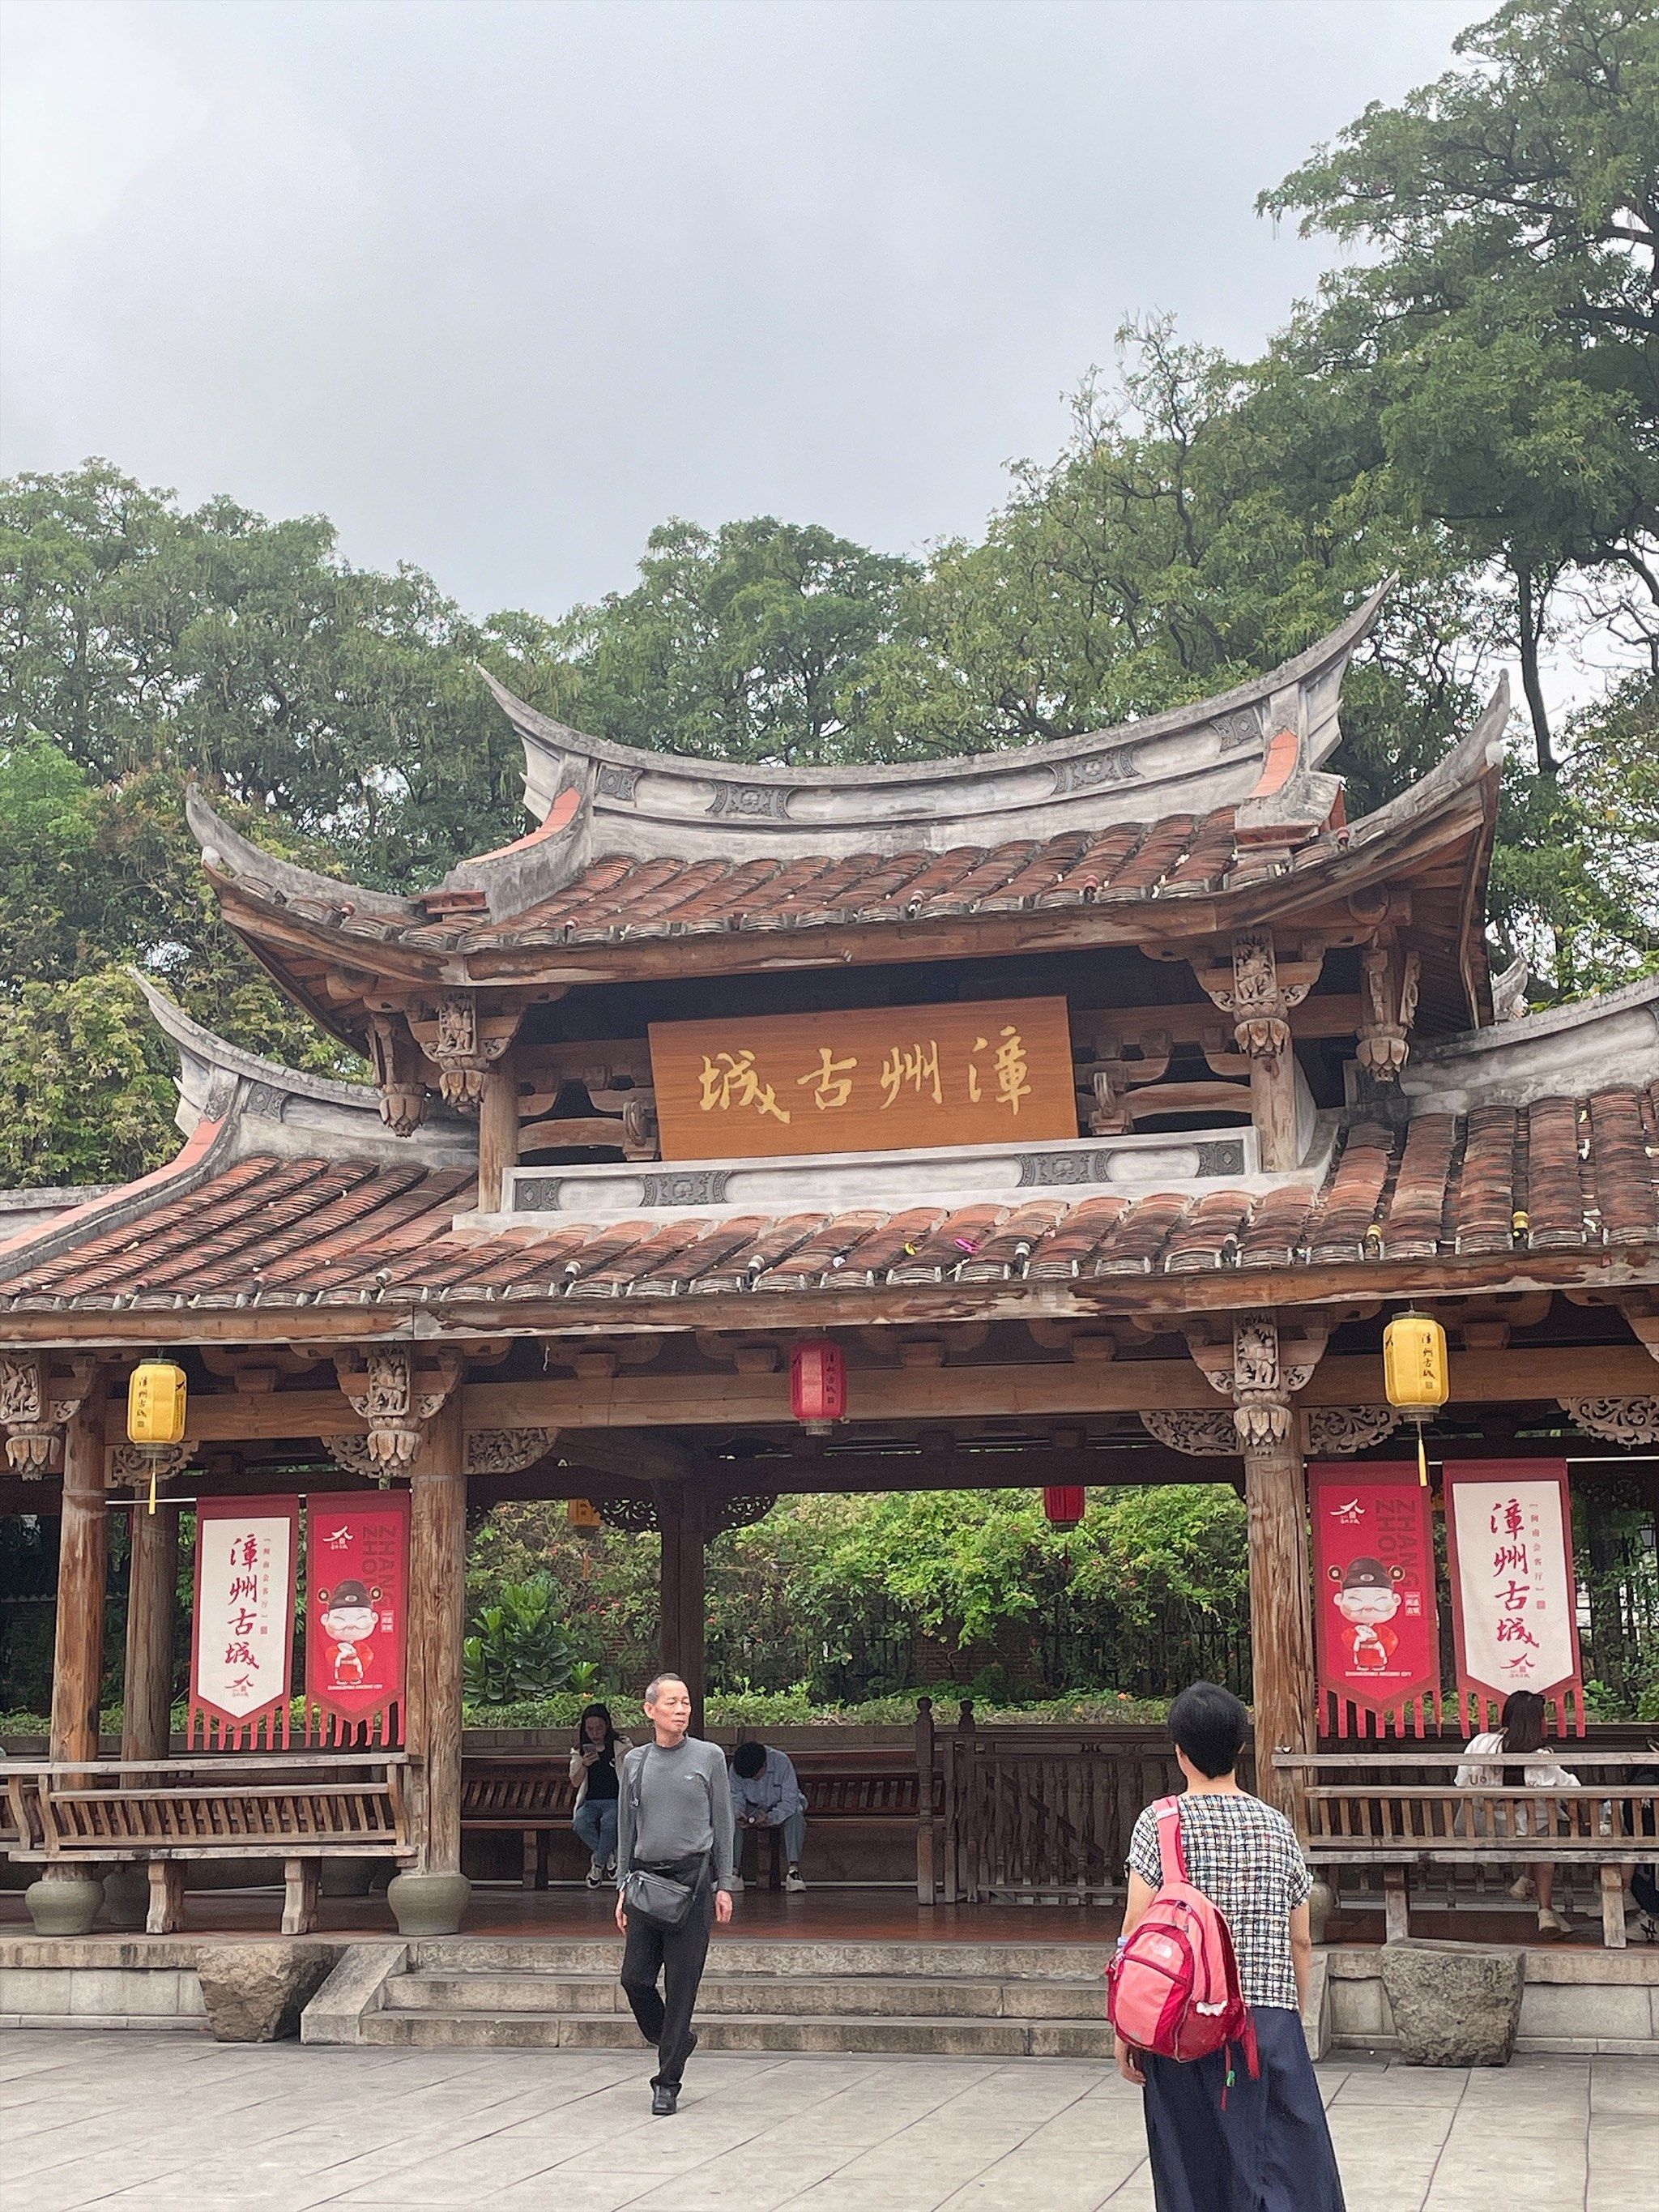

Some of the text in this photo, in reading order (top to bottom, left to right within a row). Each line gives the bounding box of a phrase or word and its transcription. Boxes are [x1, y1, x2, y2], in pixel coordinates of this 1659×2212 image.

[699, 1025, 1032, 1125] 漳州古城
[224, 1533, 260, 1669] 漳州古城
[1490, 1498, 1540, 1649] 漳州古城
